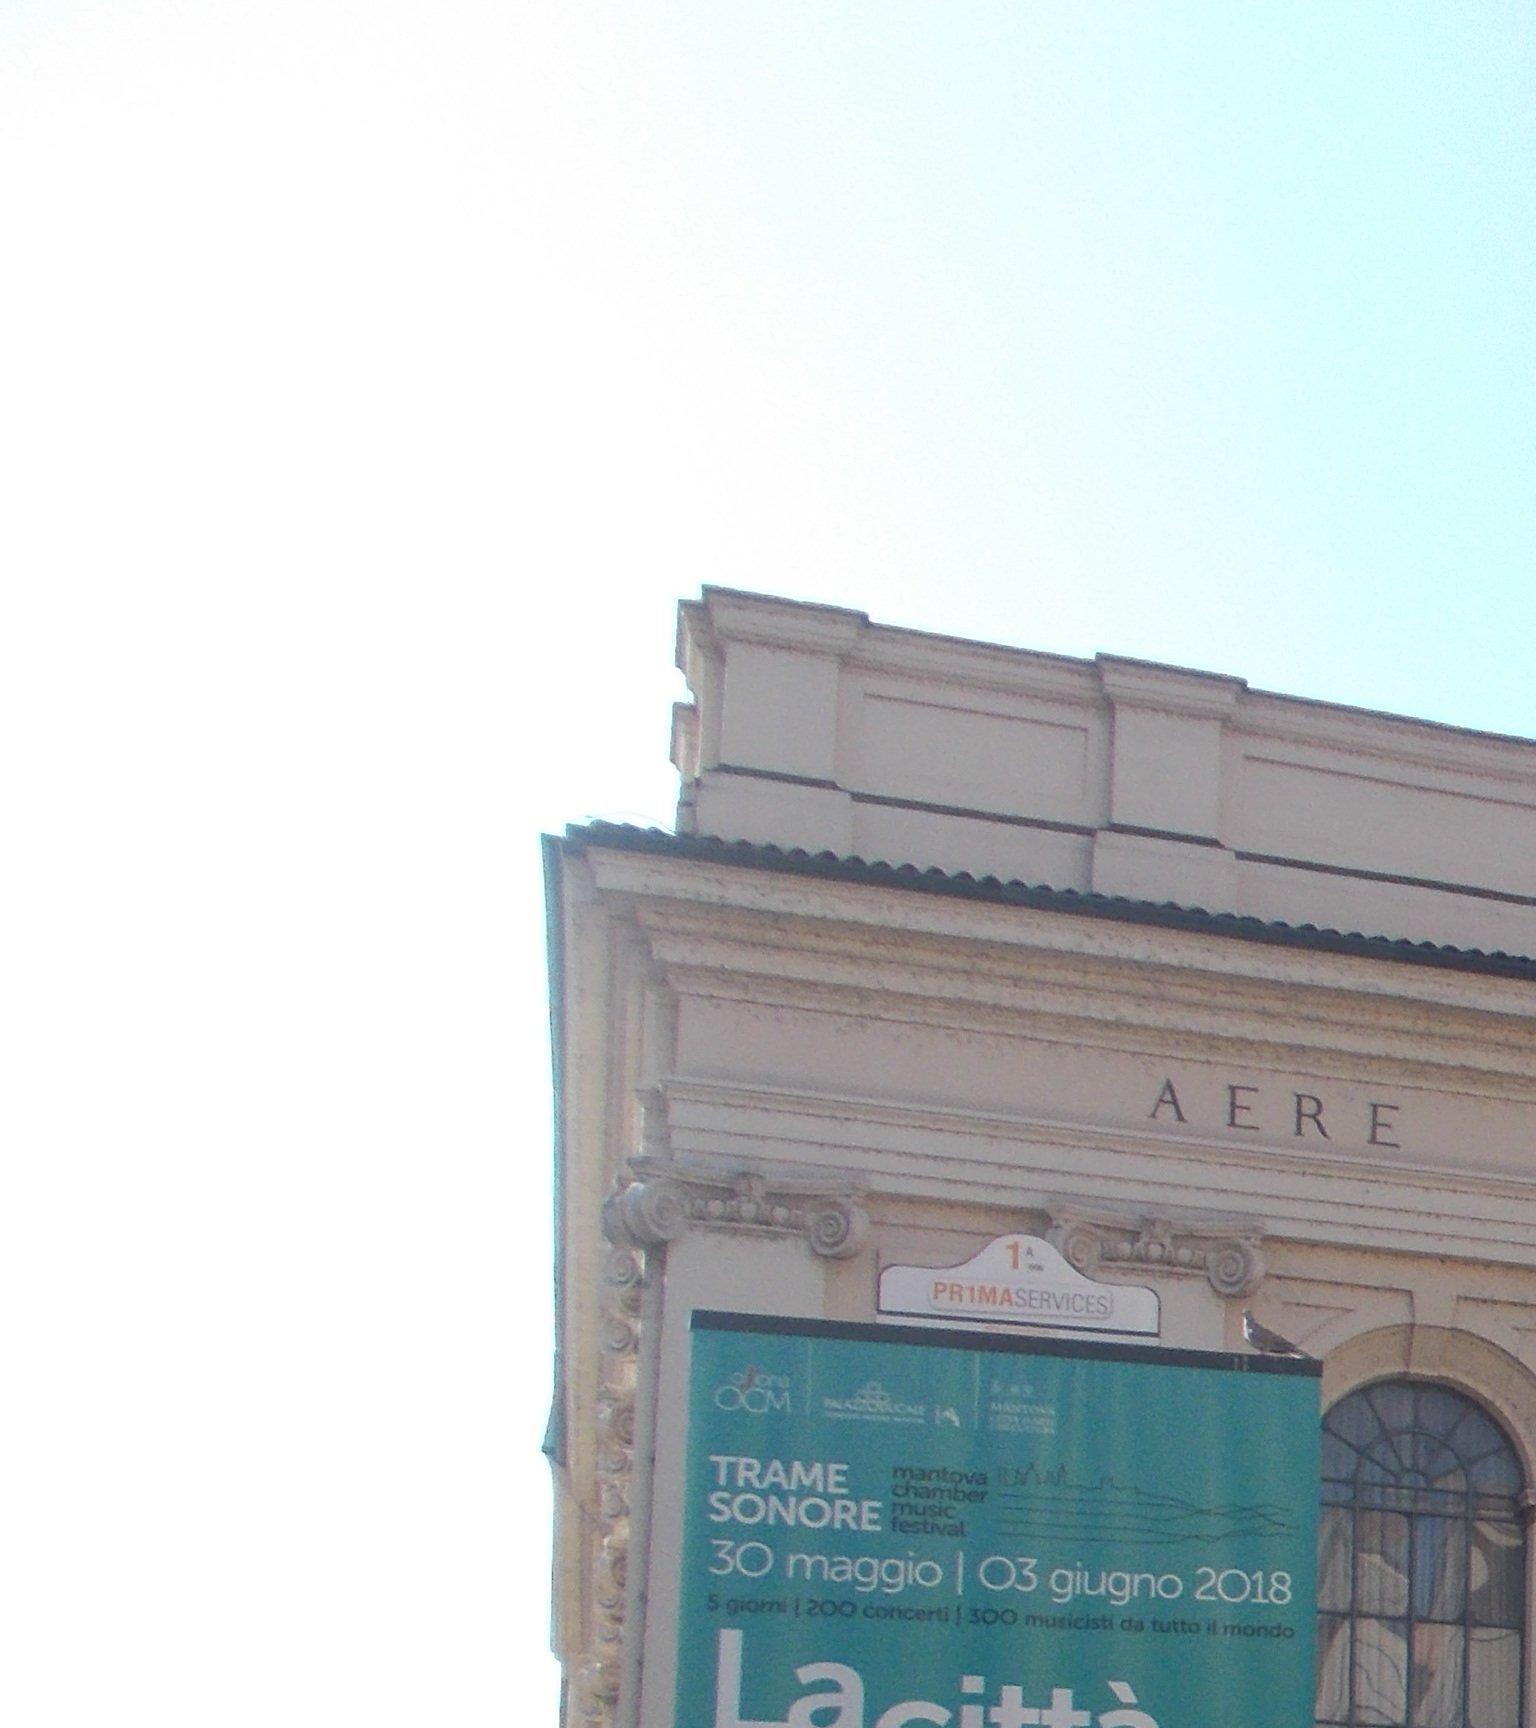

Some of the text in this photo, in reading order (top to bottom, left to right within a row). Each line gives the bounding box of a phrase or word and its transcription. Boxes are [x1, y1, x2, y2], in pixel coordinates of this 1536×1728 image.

[1147, 1078, 1402, 1149] AERE
[709, 1454, 849, 1494] TRAME
[892, 1466, 988, 1486] mantova
[892, 1481, 989, 1504] chamber
[709, 1491, 882, 1532] SONORE
[891, 1516, 966, 1538] festival
[892, 1501, 956, 1519] music
[709, 1539, 773, 1578] 30
[787, 1551, 943, 1593] maggio
[979, 1556, 1038, 1592] 03
[1050, 1562, 1184, 1606] giugno
[1194, 1567, 1294, 1605] 2018
[726, 1594, 788, 1618] giorni
[806, 1598, 858, 1618] 200
[862, 1600, 950, 1623] concerti
[969, 1606, 1018, 1626] 300
[1025, 1610, 1114, 1632] musicisti
[1120, 1614, 1145, 1634] da
[1152, 1615, 1200, 1635] tutto
[1207, 1617, 1218, 1636] il
[1223, 1618, 1295, 1640] mondo
